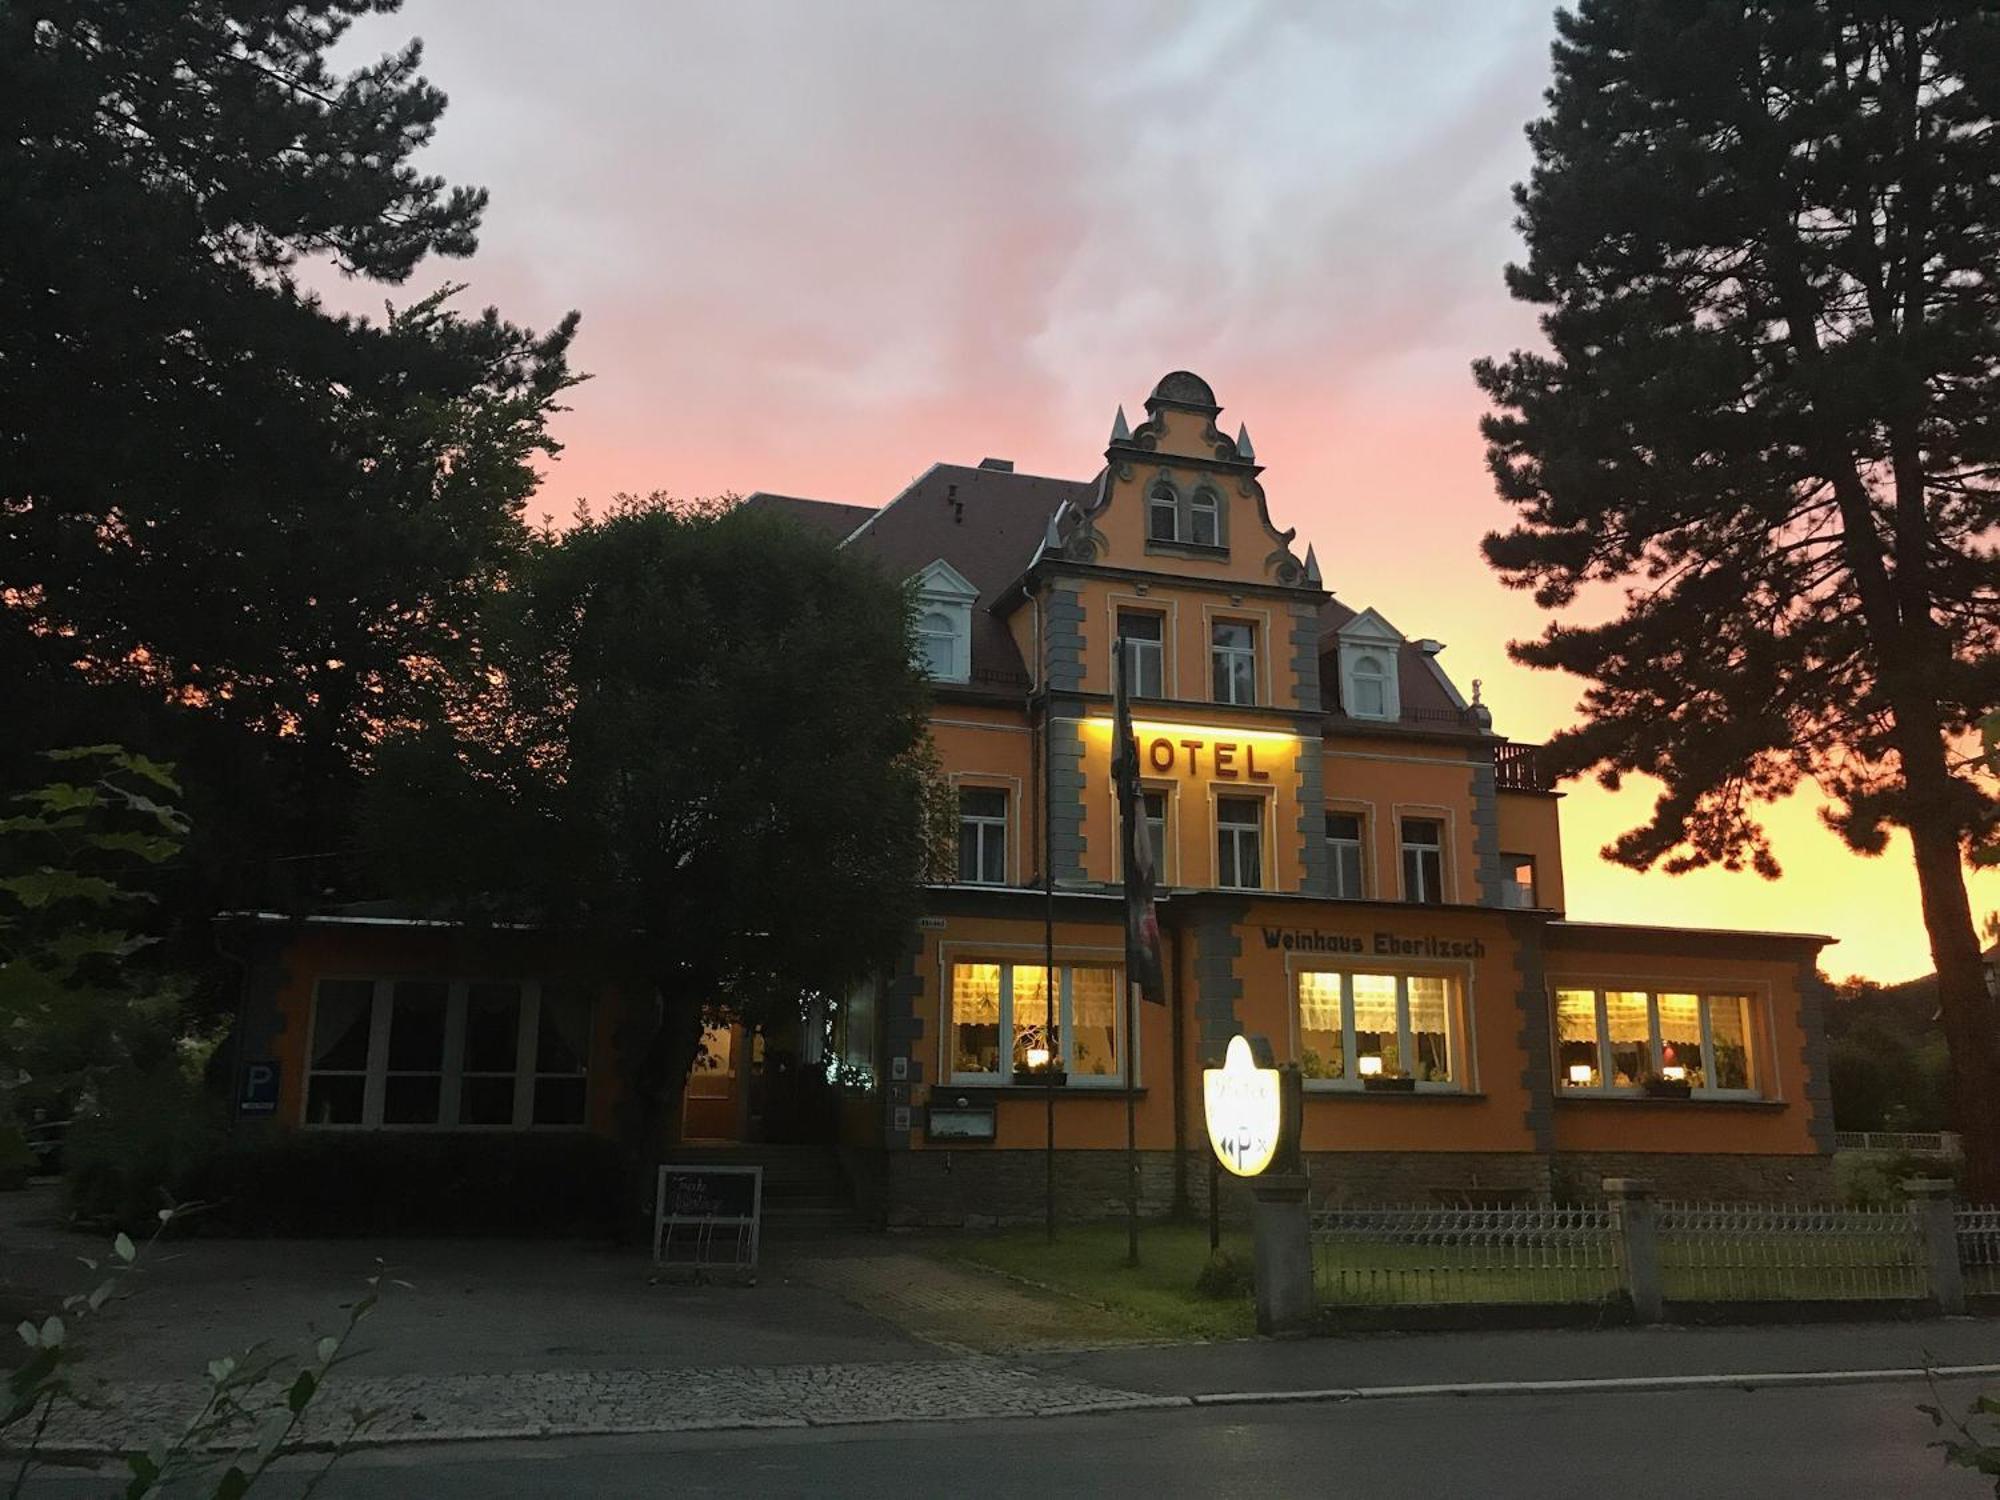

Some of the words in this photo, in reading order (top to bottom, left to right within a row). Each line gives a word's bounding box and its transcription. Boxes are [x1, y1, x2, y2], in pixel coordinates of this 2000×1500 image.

[1133, 735, 1269, 780] OTEL
[1262, 927, 1364, 952] Weinhaus
[1373, 931, 1486, 959] Eberitzsch
[247, 1066, 273, 1098] P
